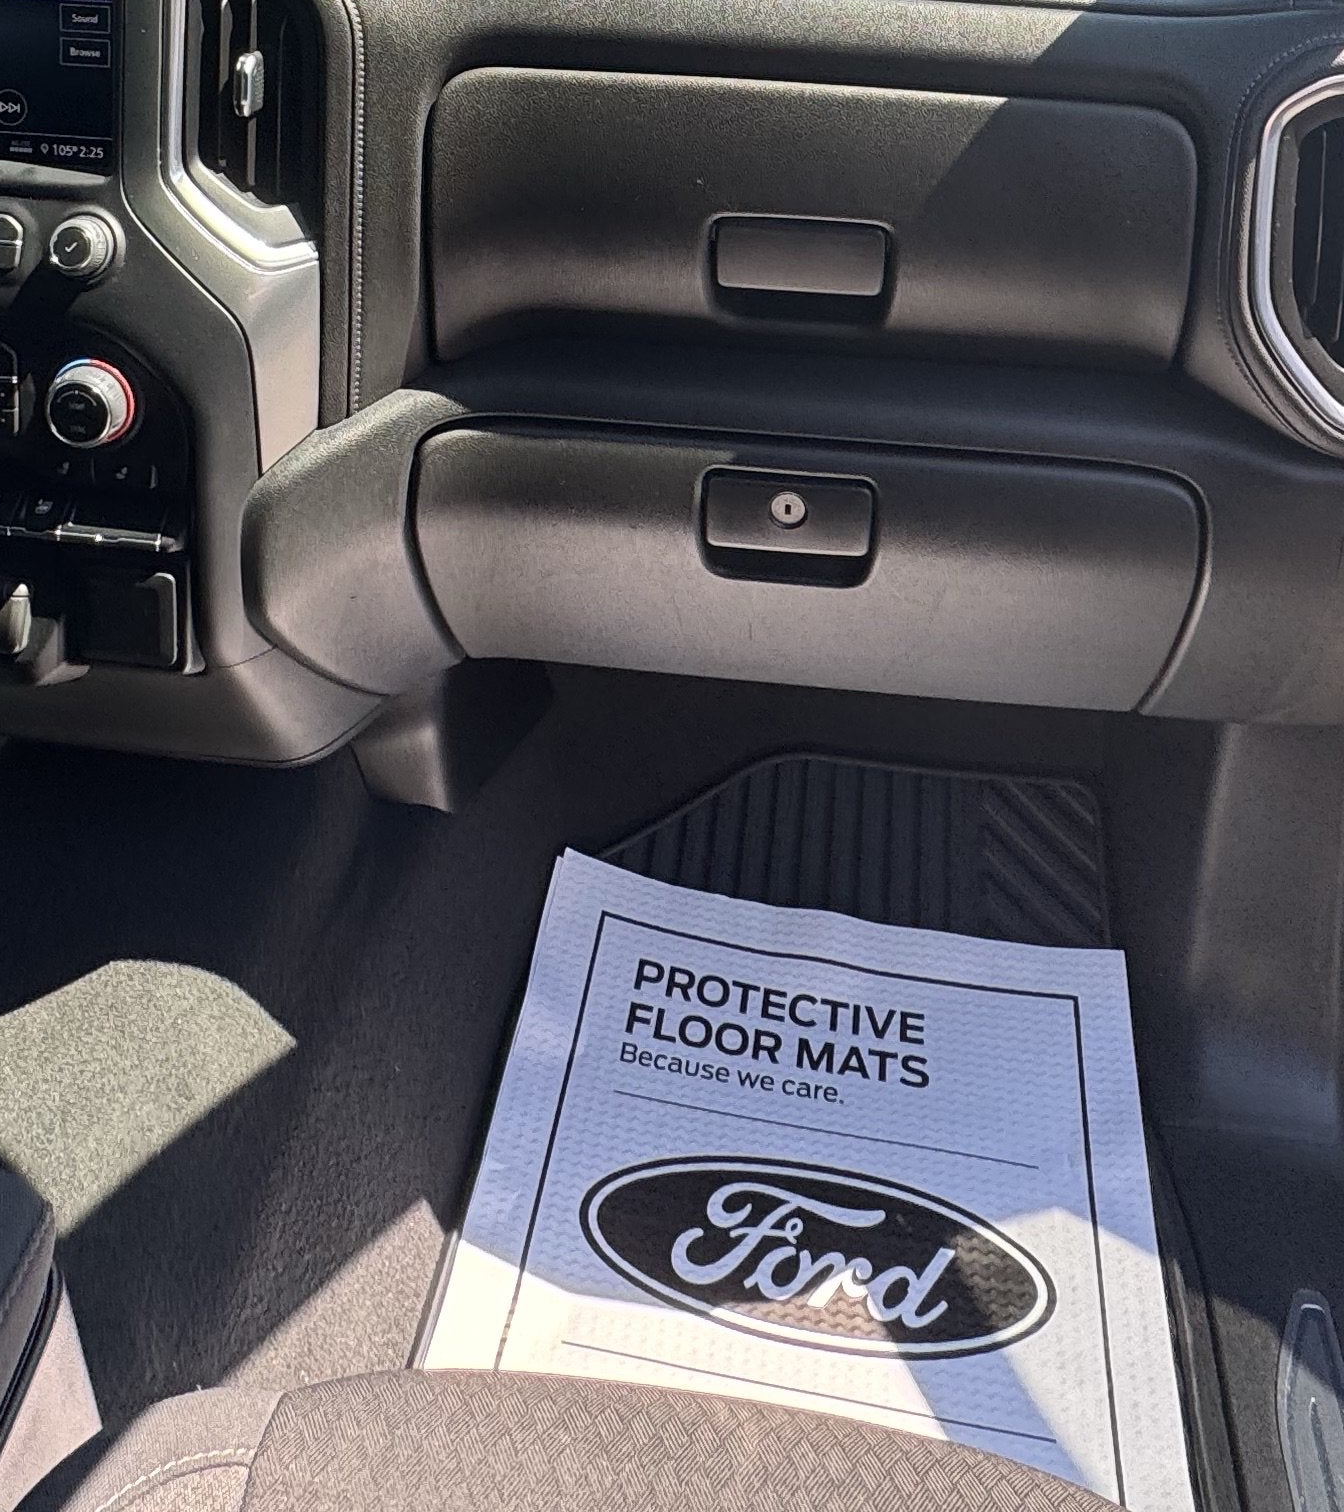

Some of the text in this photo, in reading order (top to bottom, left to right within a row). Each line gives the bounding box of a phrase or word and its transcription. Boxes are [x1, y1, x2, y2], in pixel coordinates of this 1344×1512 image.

[71, 13, 99, 24] Sound
[69, 46, 101, 58] Browse
[78, 145, 104, 159] 2:25
[633, 958, 925, 1046] PROTECTIVE
[619, 1041, 845, 1105] Because we care.
[625, 1001, 931, 1089] FLOOR MATS
[671, 1180, 957, 1329] Ford
